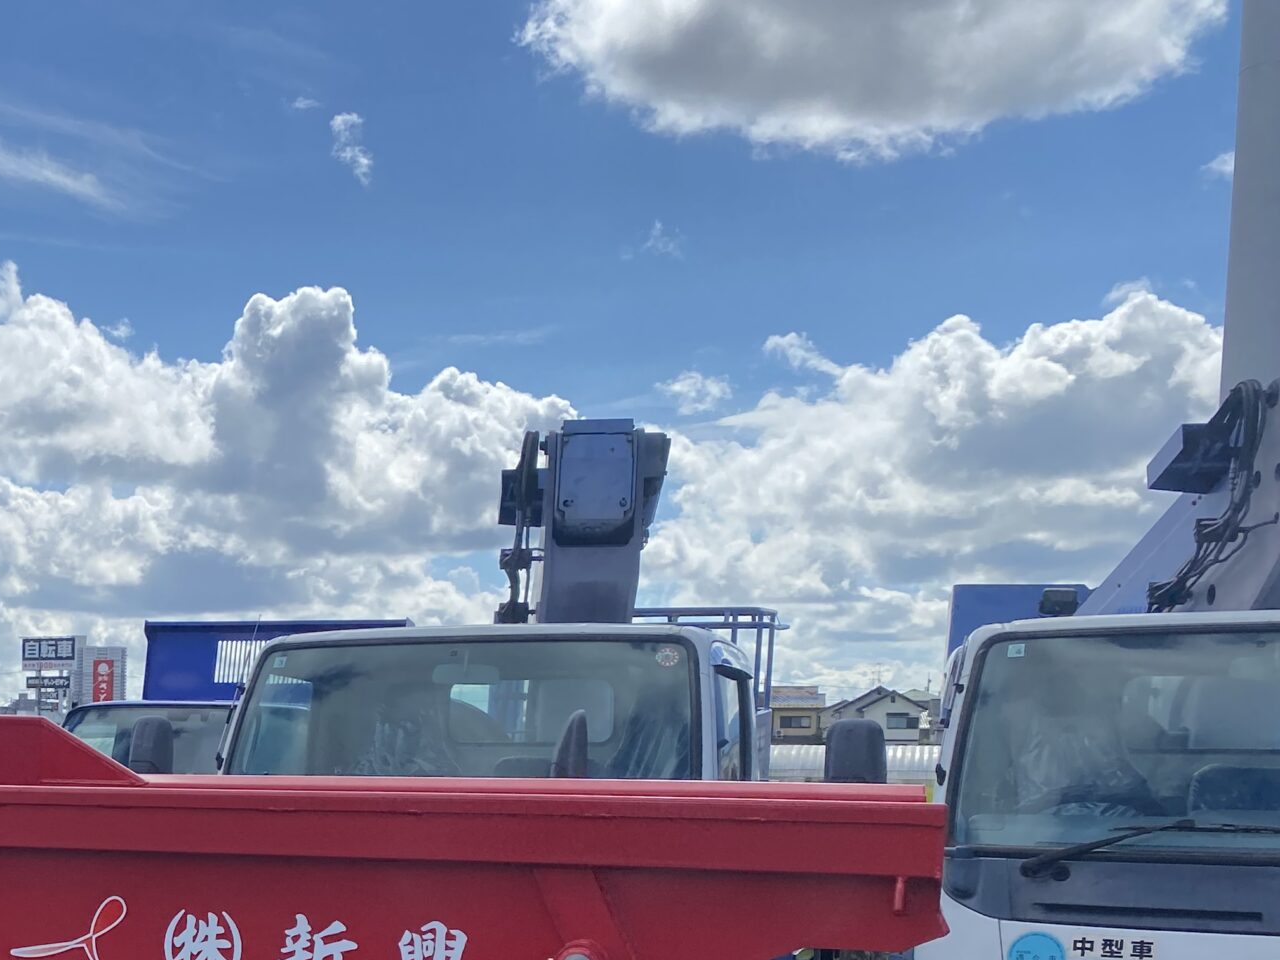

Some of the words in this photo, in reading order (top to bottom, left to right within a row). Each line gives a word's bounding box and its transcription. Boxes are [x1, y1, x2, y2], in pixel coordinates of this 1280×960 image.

[24, 640, 73, 658] 自転車
[1072, 936, 1154, 960] 中型車
